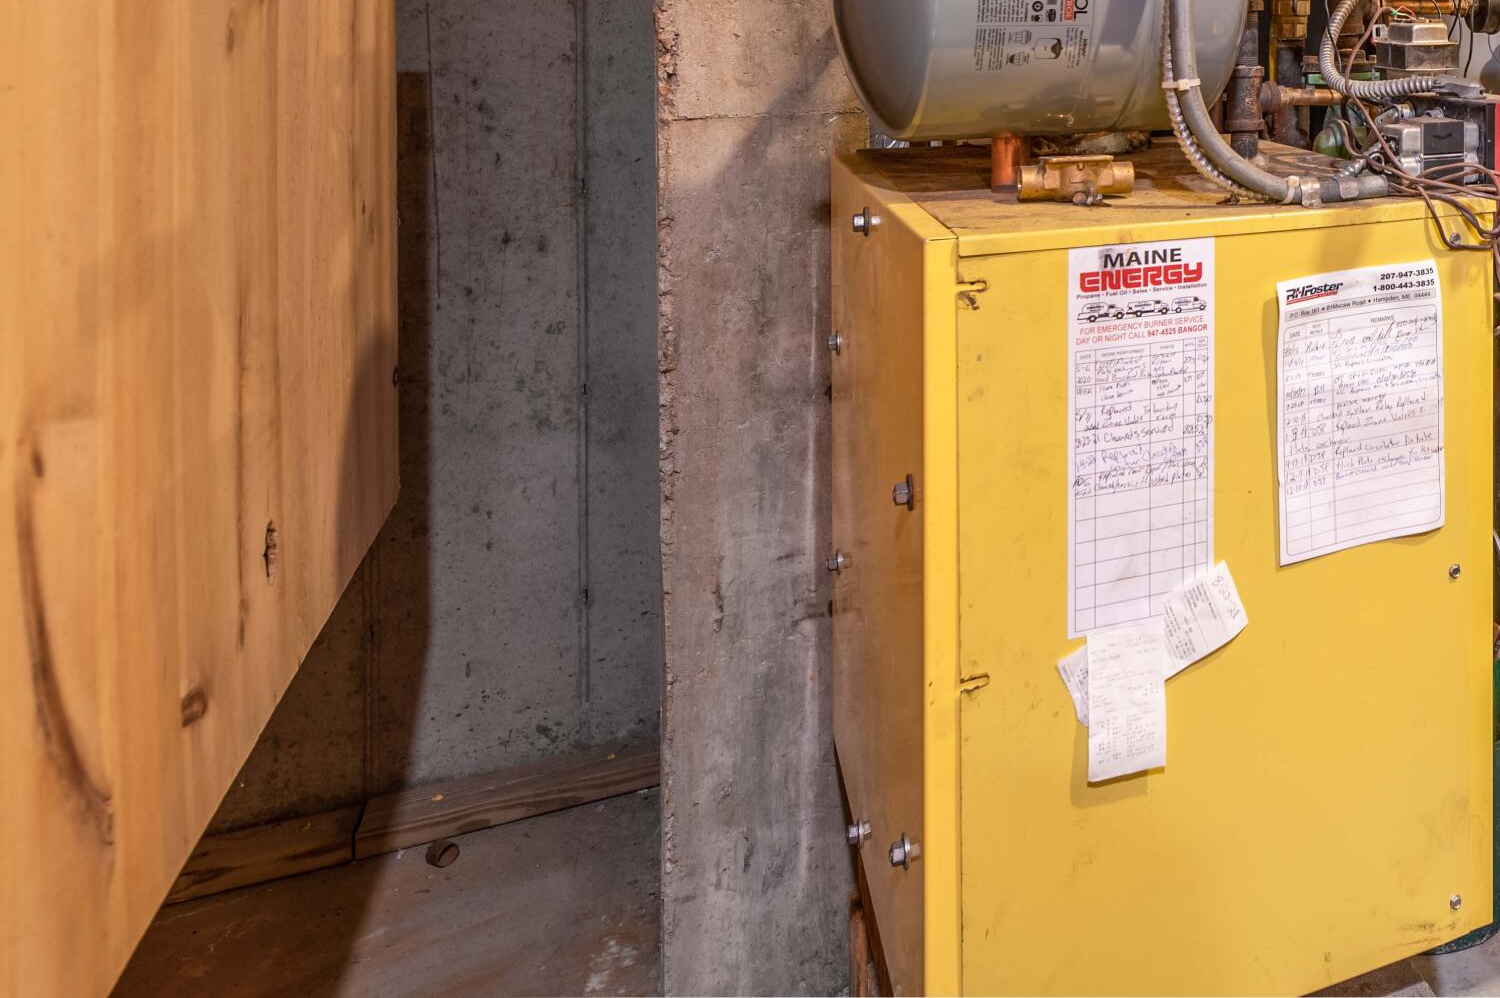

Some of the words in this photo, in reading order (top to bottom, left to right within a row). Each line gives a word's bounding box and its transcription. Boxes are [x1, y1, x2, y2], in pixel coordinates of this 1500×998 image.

[1103, 248, 1182, 269] MAINE
[1079, 261, 1203, 293] ENERGY
[1380, 267, 1434, 281] 207-947-3835
[1177, 282, 1208, 290] Installation
[1373, 278, 1435, 292] 1-800-443-3835
[1300, 309, 1311, 317] Box
[1351, 299, 1367, 307] Road
[1373, 295, 1399, 304] Hampden,
[1080, 327, 1096, 336] FOR
[1097, 323, 1143, 334] EMERGENCY
[1144, 319, 1174, 329] BURNER
[1174, 315, 1204, 326] SERVICE
[1370, 315, 1394, 324] REMARKS
[1076, 337, 1091, 346] DAY
[1091, 335, 1104, 343] OR
[1104, 333, 1128, 342] NIGHT
[1128, 330, 1146, 340] CALL
[1147, 327, 1177, 338] 947-4525
[1177, 324, 1208, 334] BANGOR
[1289, 331, 1301, 339] DATE
